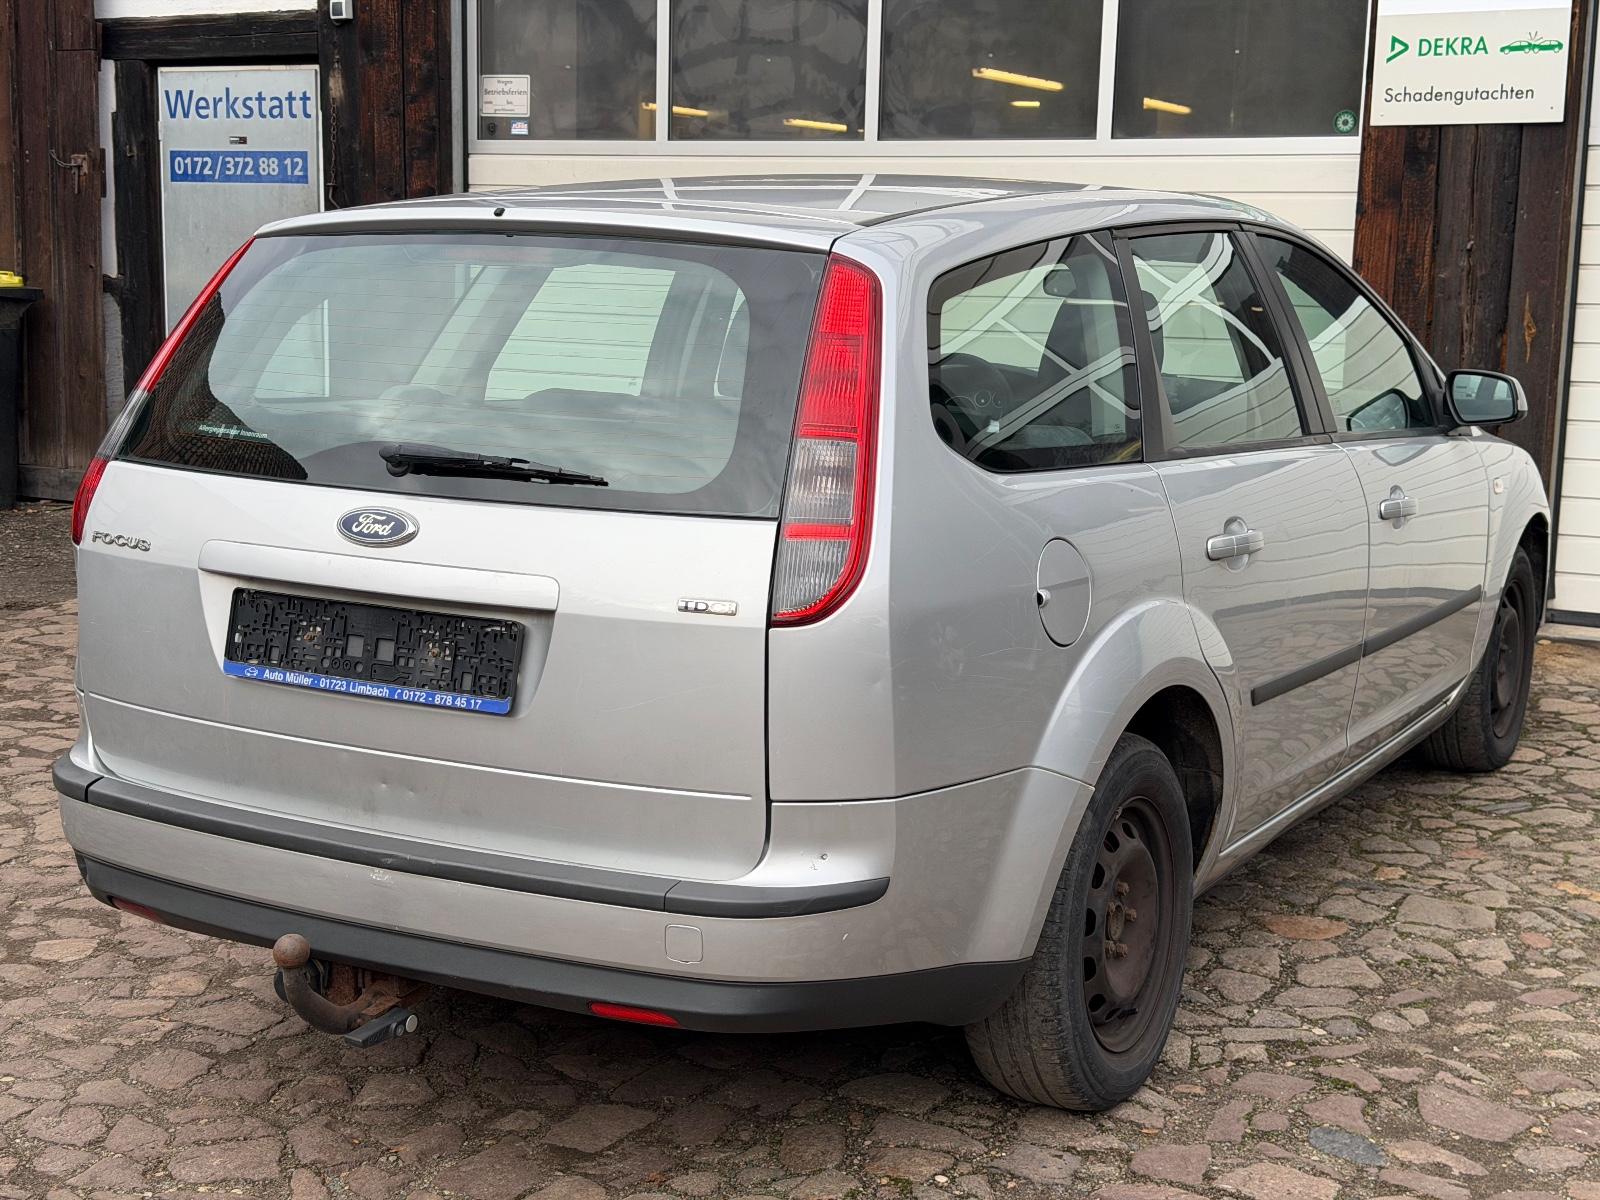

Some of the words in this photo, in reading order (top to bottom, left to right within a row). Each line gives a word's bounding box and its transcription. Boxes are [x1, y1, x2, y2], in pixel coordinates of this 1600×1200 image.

[1417, 35, 1489, 57] DEKRA
[164, 87, 312, 120] Werkstatt
[1384, 84, 1535, 105] Schadengutachten
[174, 156, 254, 180] 0172/372
[258, 157, 279, 176] 88
[284, 157, 304, 176] 12
[351, 513, 396, 536] Ford
[91, 530, 152, 552] FOCUS
[263, 669, 283, 681] Auto
[285, 671, 313, 686] Müller
[319, 678, 346, 691] 01723
[349, 681, 389, 698] Limbach
[402, 690, 426, 703] 0172
[434, 694, 453, 706] 878
[454, 696, 467, 708] 45
[470, 699, 482, 710] 17
